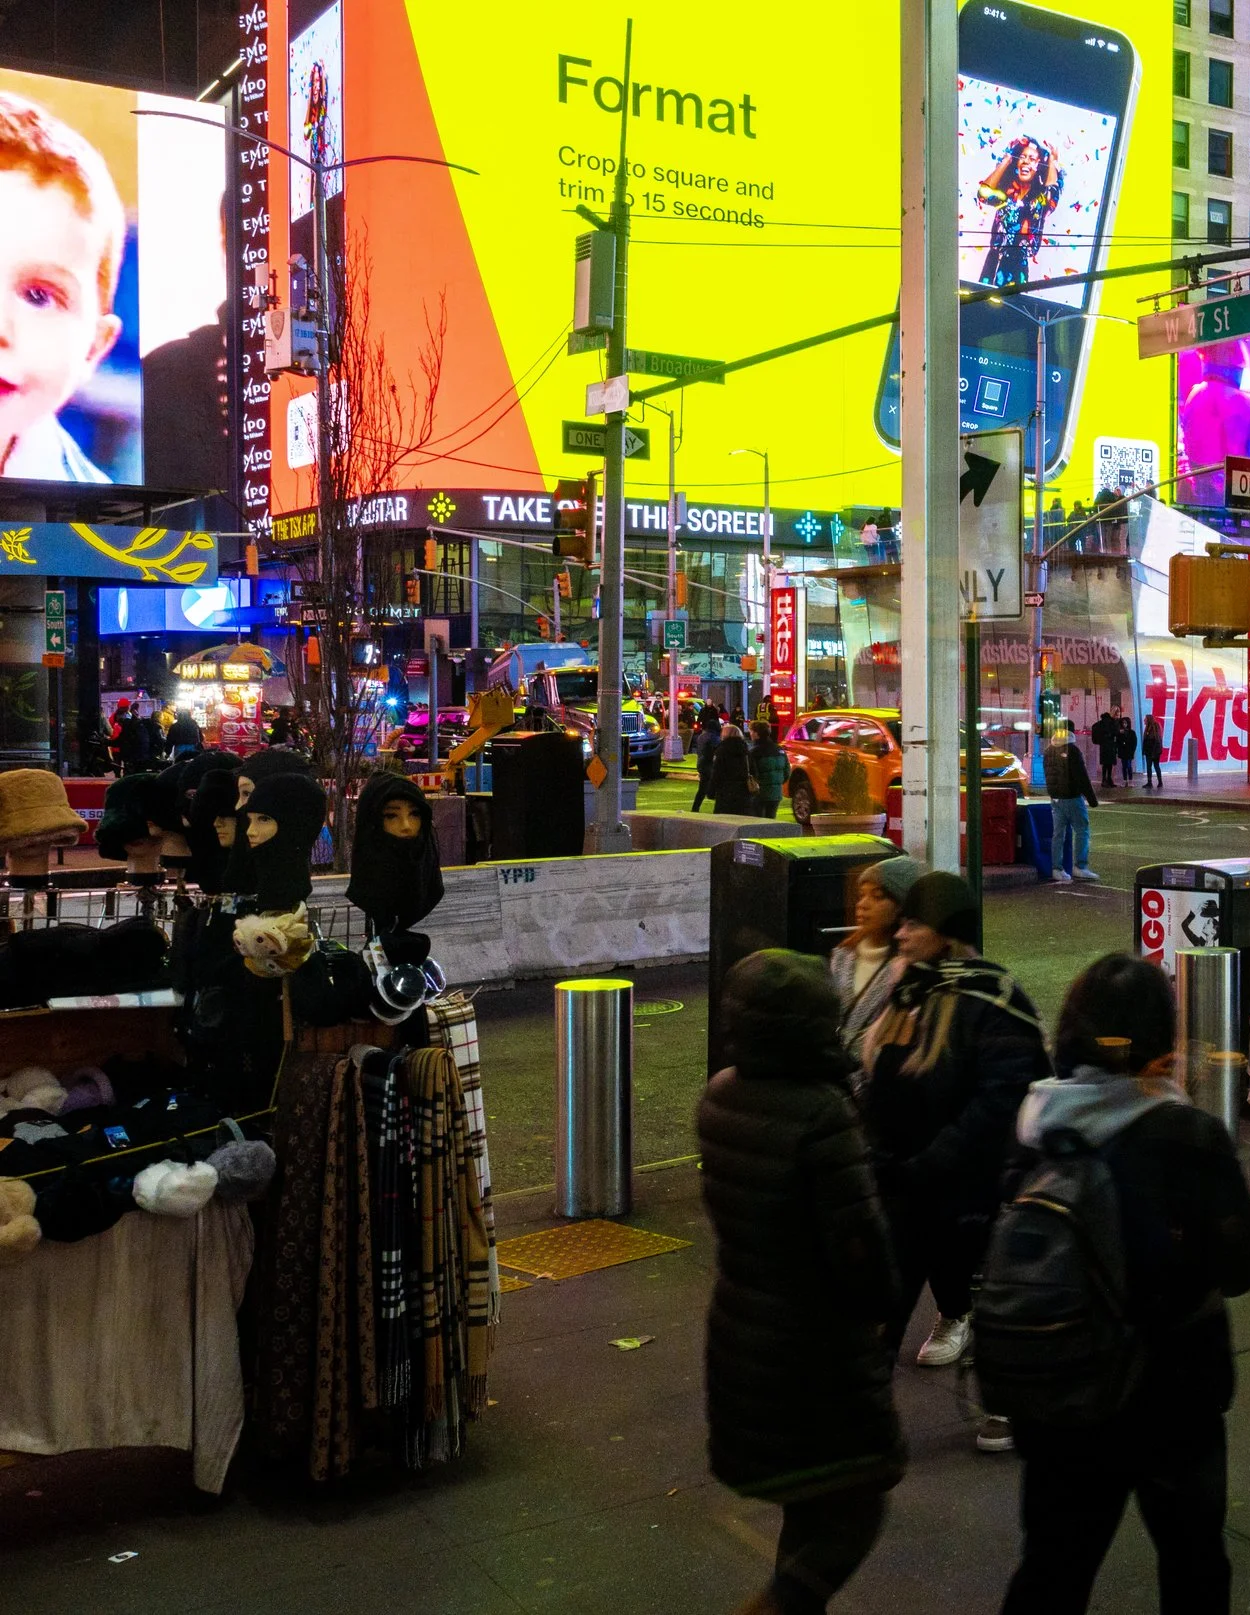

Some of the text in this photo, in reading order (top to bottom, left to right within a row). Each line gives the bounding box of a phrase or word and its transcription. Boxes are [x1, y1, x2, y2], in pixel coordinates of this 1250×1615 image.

[558, 53, 757, 139] Format
[558, 145, 774, 200] Crop to square and
[558, 178, 604, 203] trim
[642, 191, 666, 213] 15
[673, 200, 765, 229] seconds
[1165, 306, 1231, 343] W 47 St
[651, 355, 720, 382] Broadw
[575, 431, 601, 447] ONE
[961, 420, 979, 431] CROP
[482, 496, 550, 522] TAKE
[687, 508, 774, 536] SCREEN
[960, 568, 1005, 603] NLY
[47, 620, 64, 629] South
